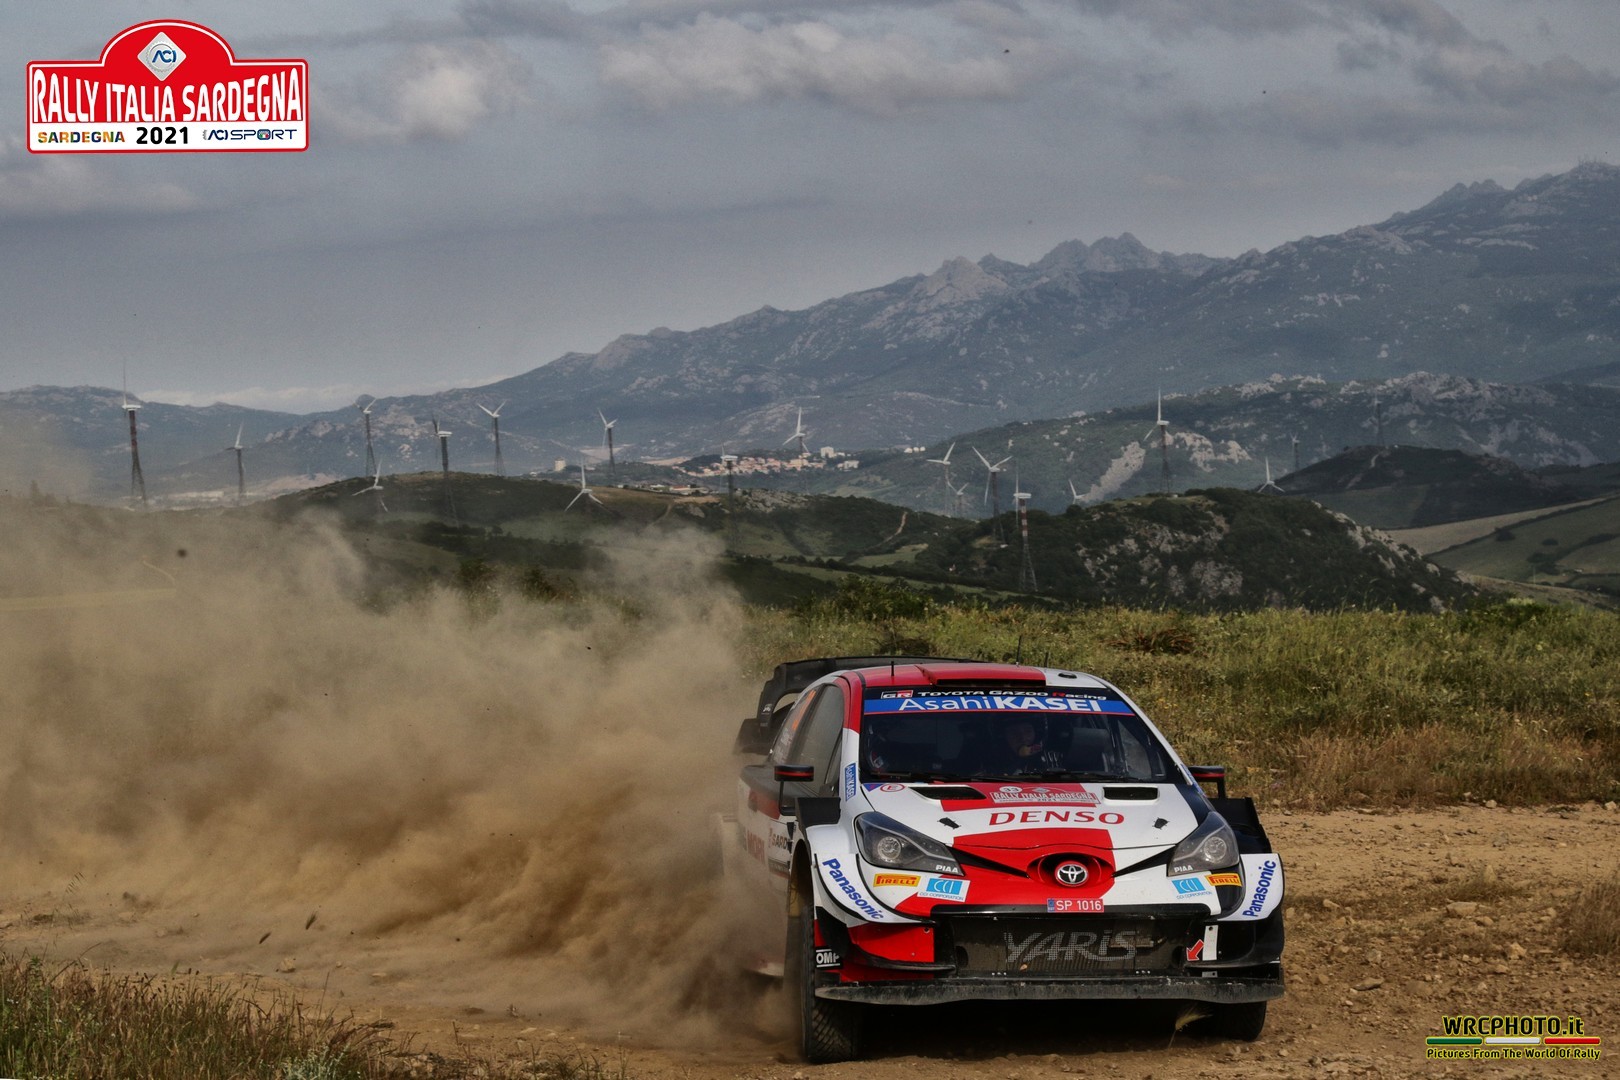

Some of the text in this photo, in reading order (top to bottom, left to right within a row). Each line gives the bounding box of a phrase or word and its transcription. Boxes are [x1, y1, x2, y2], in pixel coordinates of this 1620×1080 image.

[882, 689, 913, 699] GR
[1052, 691, 1107, 701] Racing
[994, 792, 1094, 800] RALLY ITALIA SARDEGNA
[989, 810, 1125, 826] DENSO
[935, 864, 959, 873] PIAA
[1174, 864, 1193, 873] PIAA
[875, 875, 918, 885] PIRELLI
[1208, 875, 1240, 885] PIRELLI
[822, 858, 884, 920] Panasonic
[1242, 860, 1277, 918] Panasonic
[929, 892, 964, 901] CORPORATION
[1056, 900, 1073, 911] SP
[1077, 900, 1102, 911] 1016
